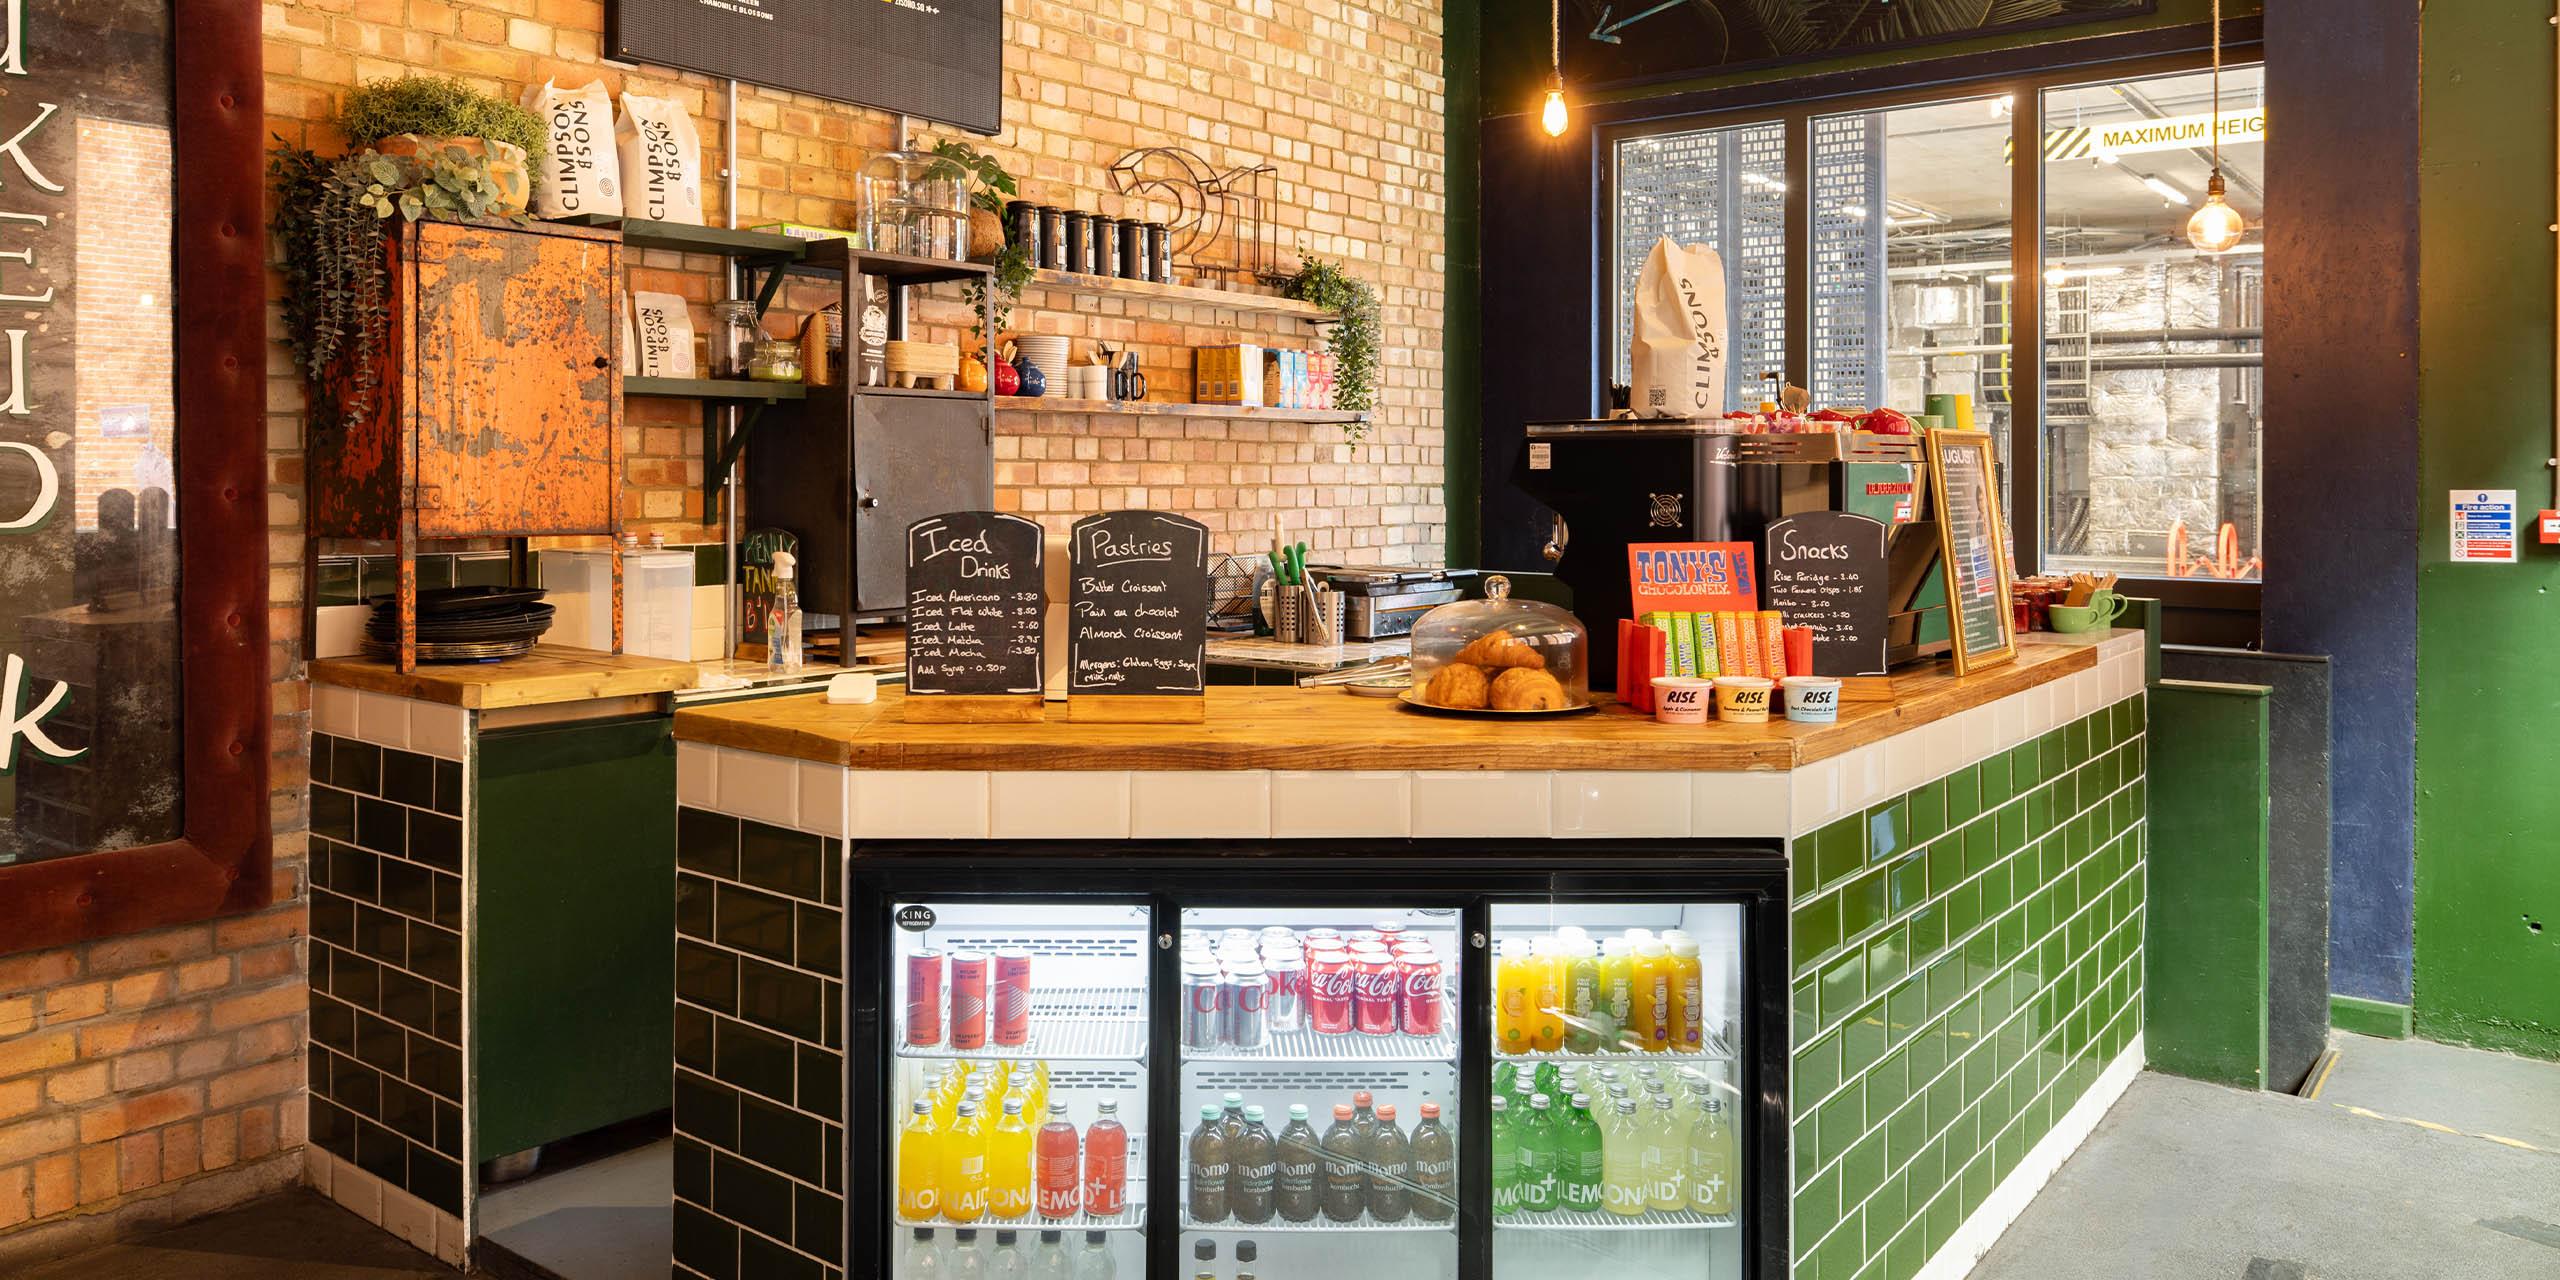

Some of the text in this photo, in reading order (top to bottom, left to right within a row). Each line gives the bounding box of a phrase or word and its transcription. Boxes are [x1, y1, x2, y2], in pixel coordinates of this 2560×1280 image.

[2103, 123, 2205, 147] MAXIMUM
[920, 526, 993, 561] Iced
[1091, 529, 1172, 559] Pastries
[1780, 529, 1849, 561] Snacks
[961, 555, 1011, 579] Drinks
[1773, 569, 1792, 582] Rise
[1796, 571, 1830, 586] Porridge
[1078, 576, 1168, 594] Butter Croissant
[1770, 584, 1788, 594] Two
[912, 589, 945, 604] Iced
[949, 589, 1001, 602] Americano
[912, 606, 944, 618] Iced
[951, 606, 973, 617] Flat
[1074, 600, 1107, 618] Pain
[1134, 602, 1180, 618] chocolat
[912, 622, 943, 632] Iced
[948, 622, 976, 632] Latte
[1079, 626, 1183, 640] Almond Croissant
[911, 635, 944, 645] Iced
[947, 635, 984, 646] Matcha
[911, 647, 944, 657] Iced
[948, 648, 986, 659] Mocha
[917, 665, 936, 675] Add
[941, 664, 965, 677] Syrup
[1667, 691, 1697, 703] RISE
[1735, 691, 1764, 703] RISE
[1803, 691, 1833, 703] RISE
[901, 910, 931, 920] KING
[1238, 1161, 1276, 1179] momo
